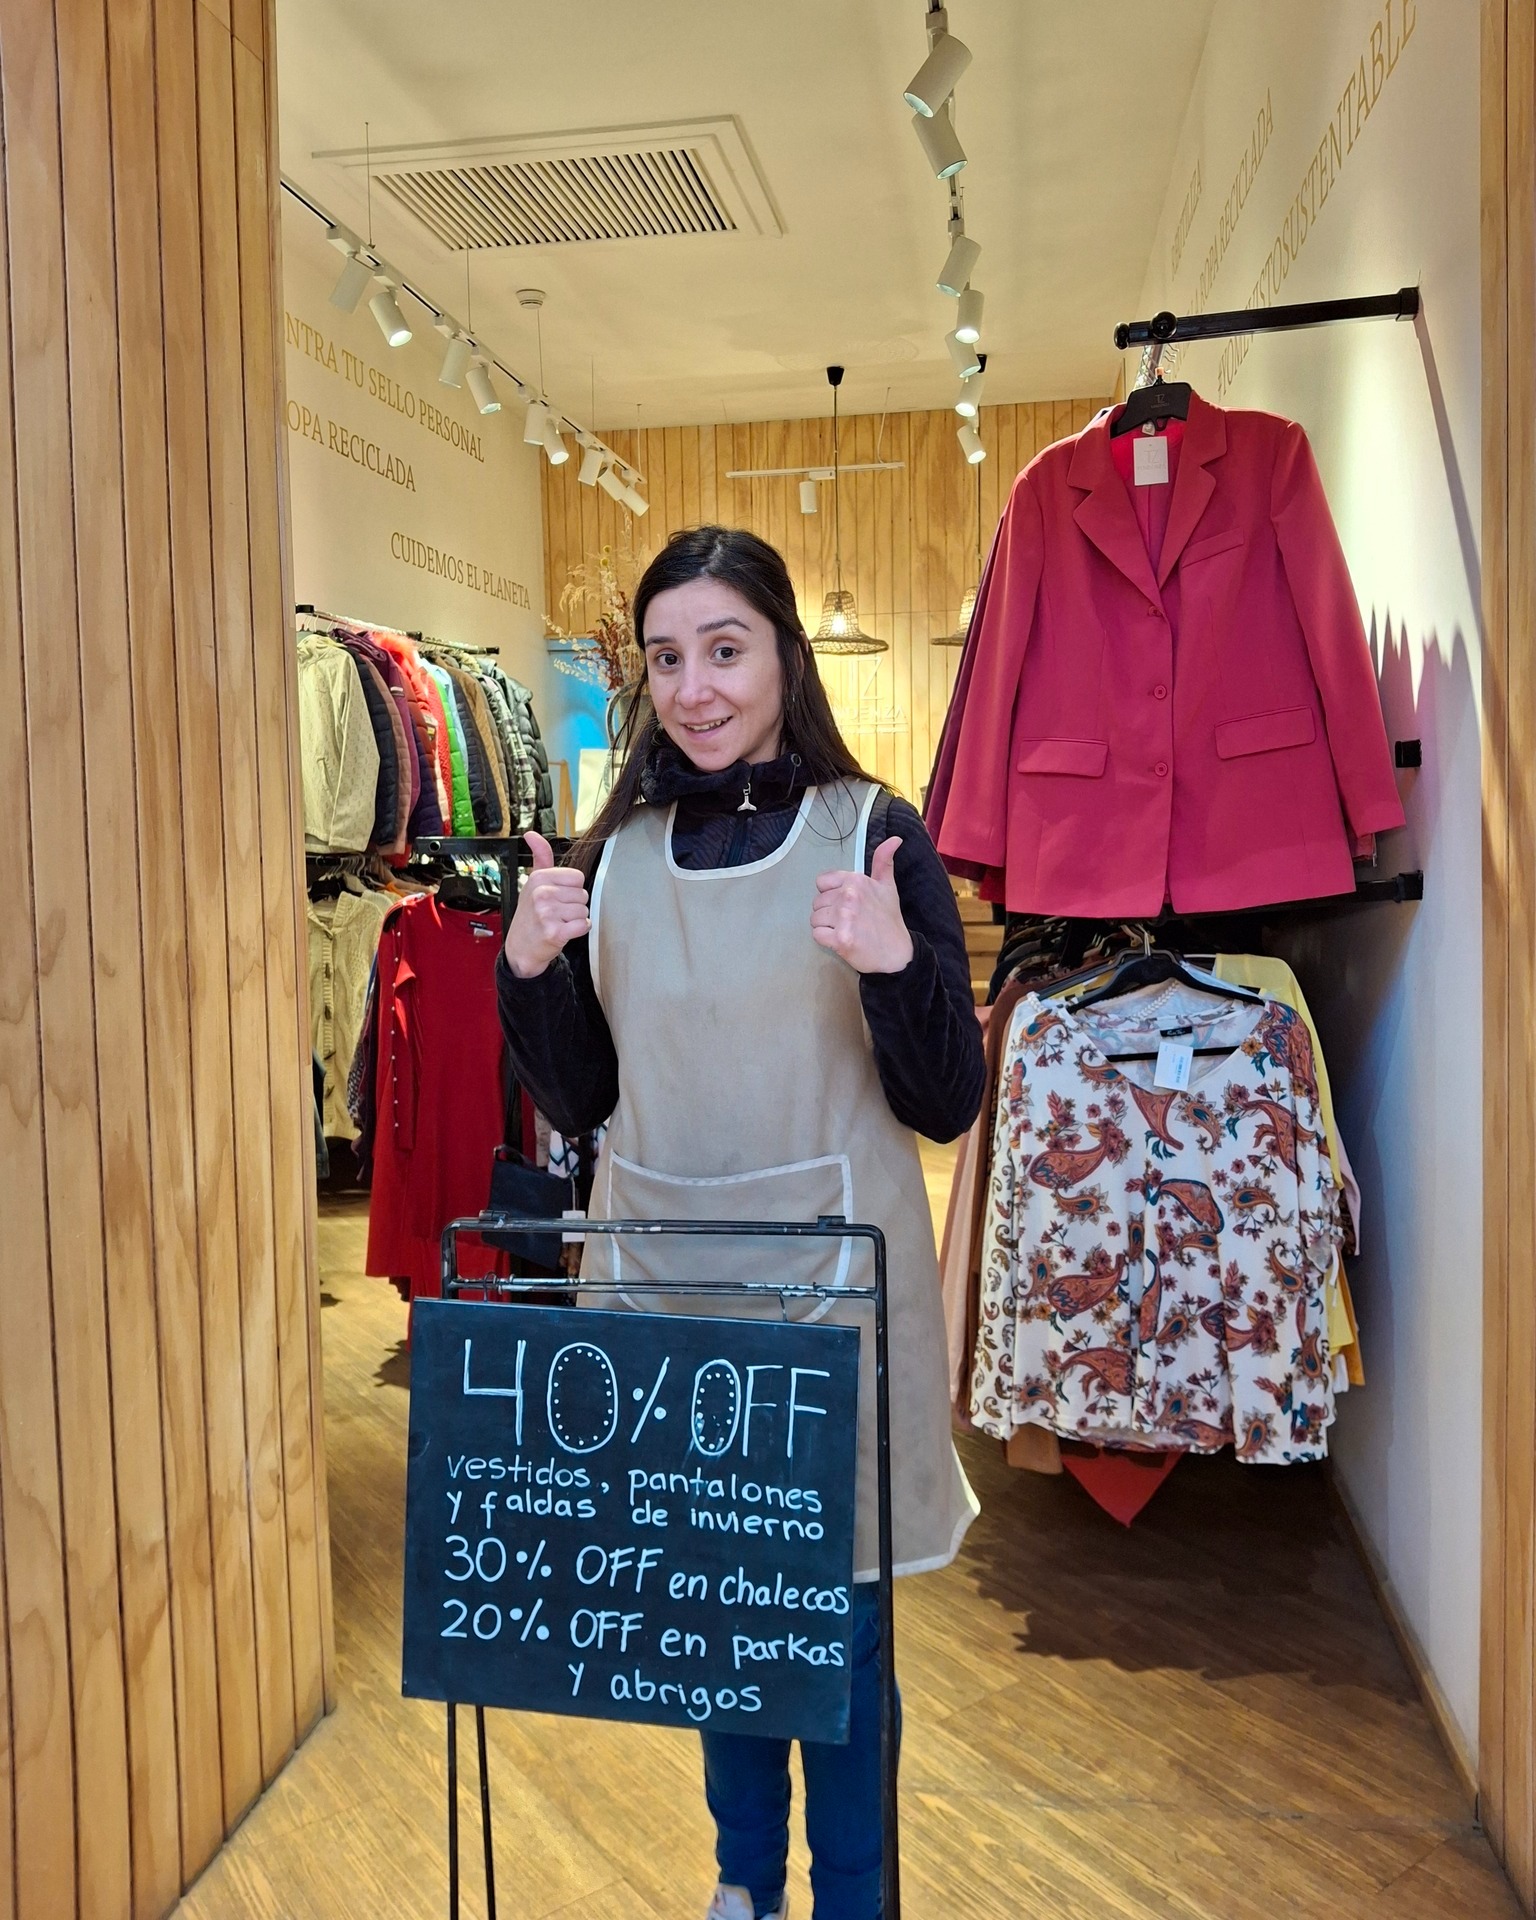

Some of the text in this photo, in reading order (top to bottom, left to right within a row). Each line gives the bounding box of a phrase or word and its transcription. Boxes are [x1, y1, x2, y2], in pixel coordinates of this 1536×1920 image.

[342, 349, 364, 388] TU
[368, 367, 416, 419] SELLO
[419, 400, 485, 463] PERSONAL
[328, 420, 416, 492] RECICLADA
[391, 531, 531, 610] CUIDEMOS EL PLANETA
[463, 1339, 830, 1457] 40% OFF
[480, 1488, 597, 1529] faldas
[631, 1504, 669, 1528] de
[690, 1506, 825, 1541] invierno
[628, 1468, 823, 1513] pantalones
[444, 1535, 850, 1615] 30% OFF en chalecos
[440, 1598, 846, 1670] 20% OFF en parkas
[610, 1668, 763, 1722] abrigos
